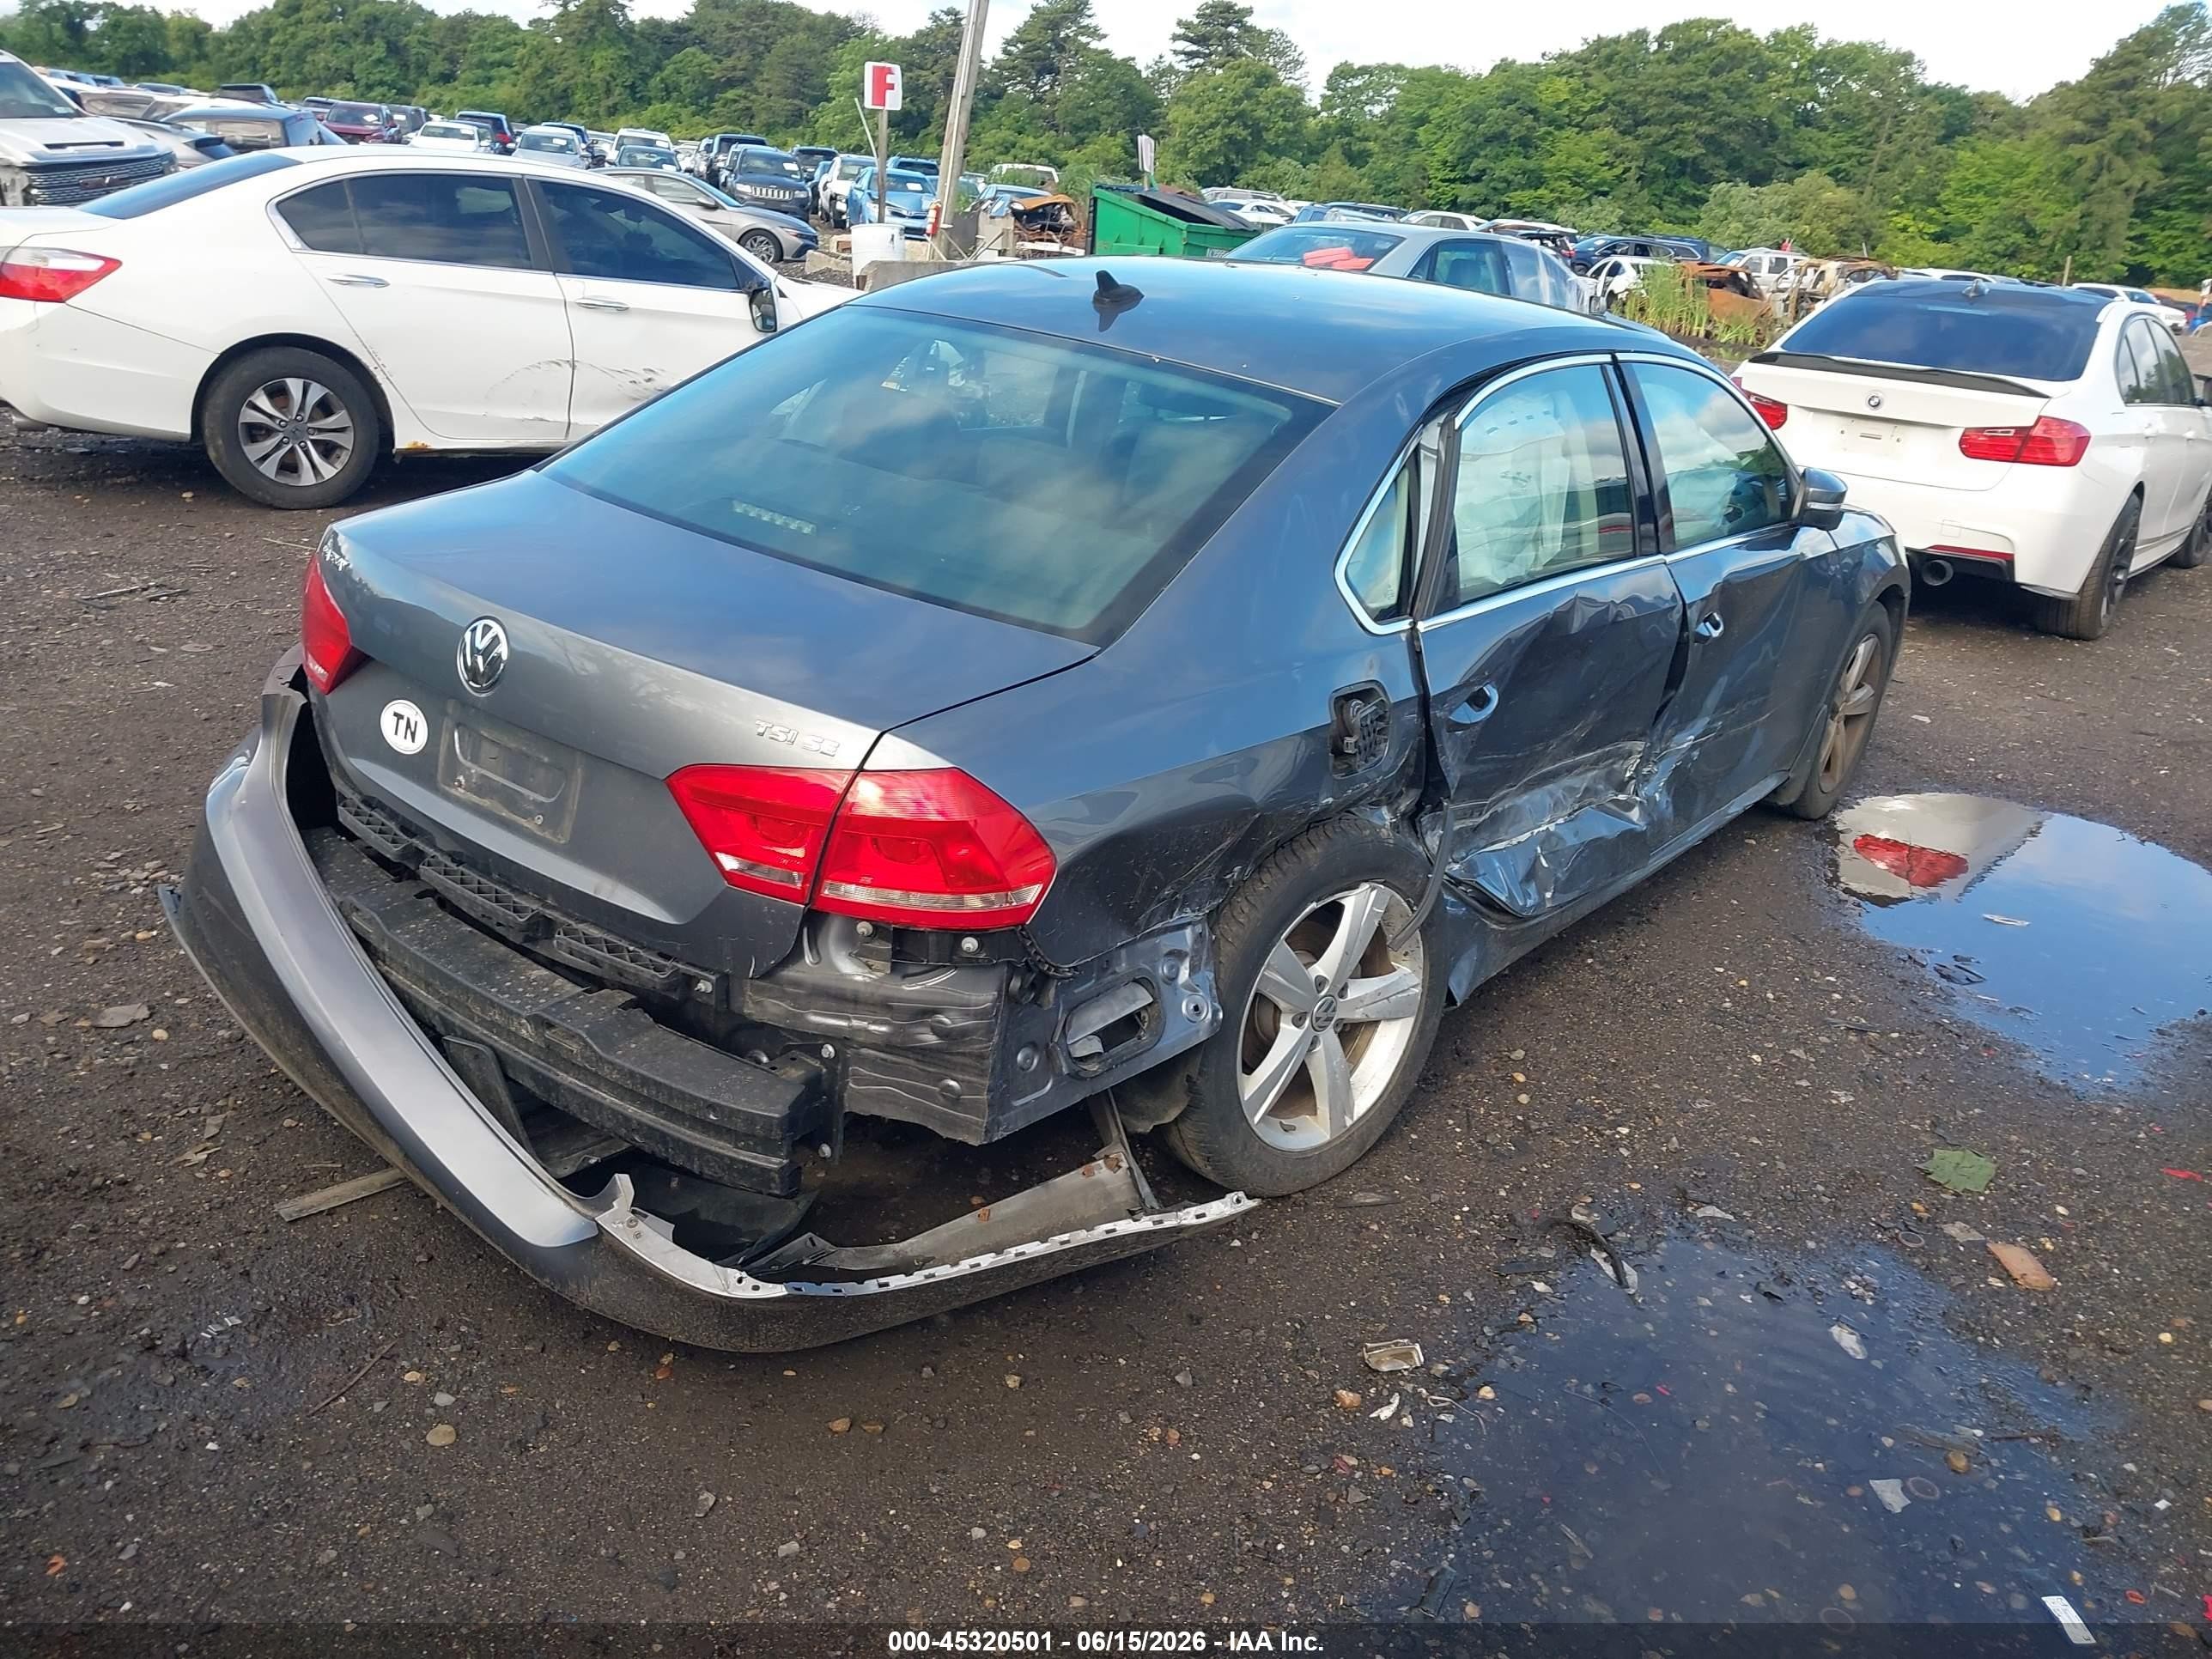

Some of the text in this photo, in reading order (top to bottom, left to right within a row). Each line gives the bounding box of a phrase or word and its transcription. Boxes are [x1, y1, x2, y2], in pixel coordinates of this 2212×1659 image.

[872, 65, 896, 106] F
[393, 711, 418, 744] TN
[756, 720, 841, 757] TSI SE
